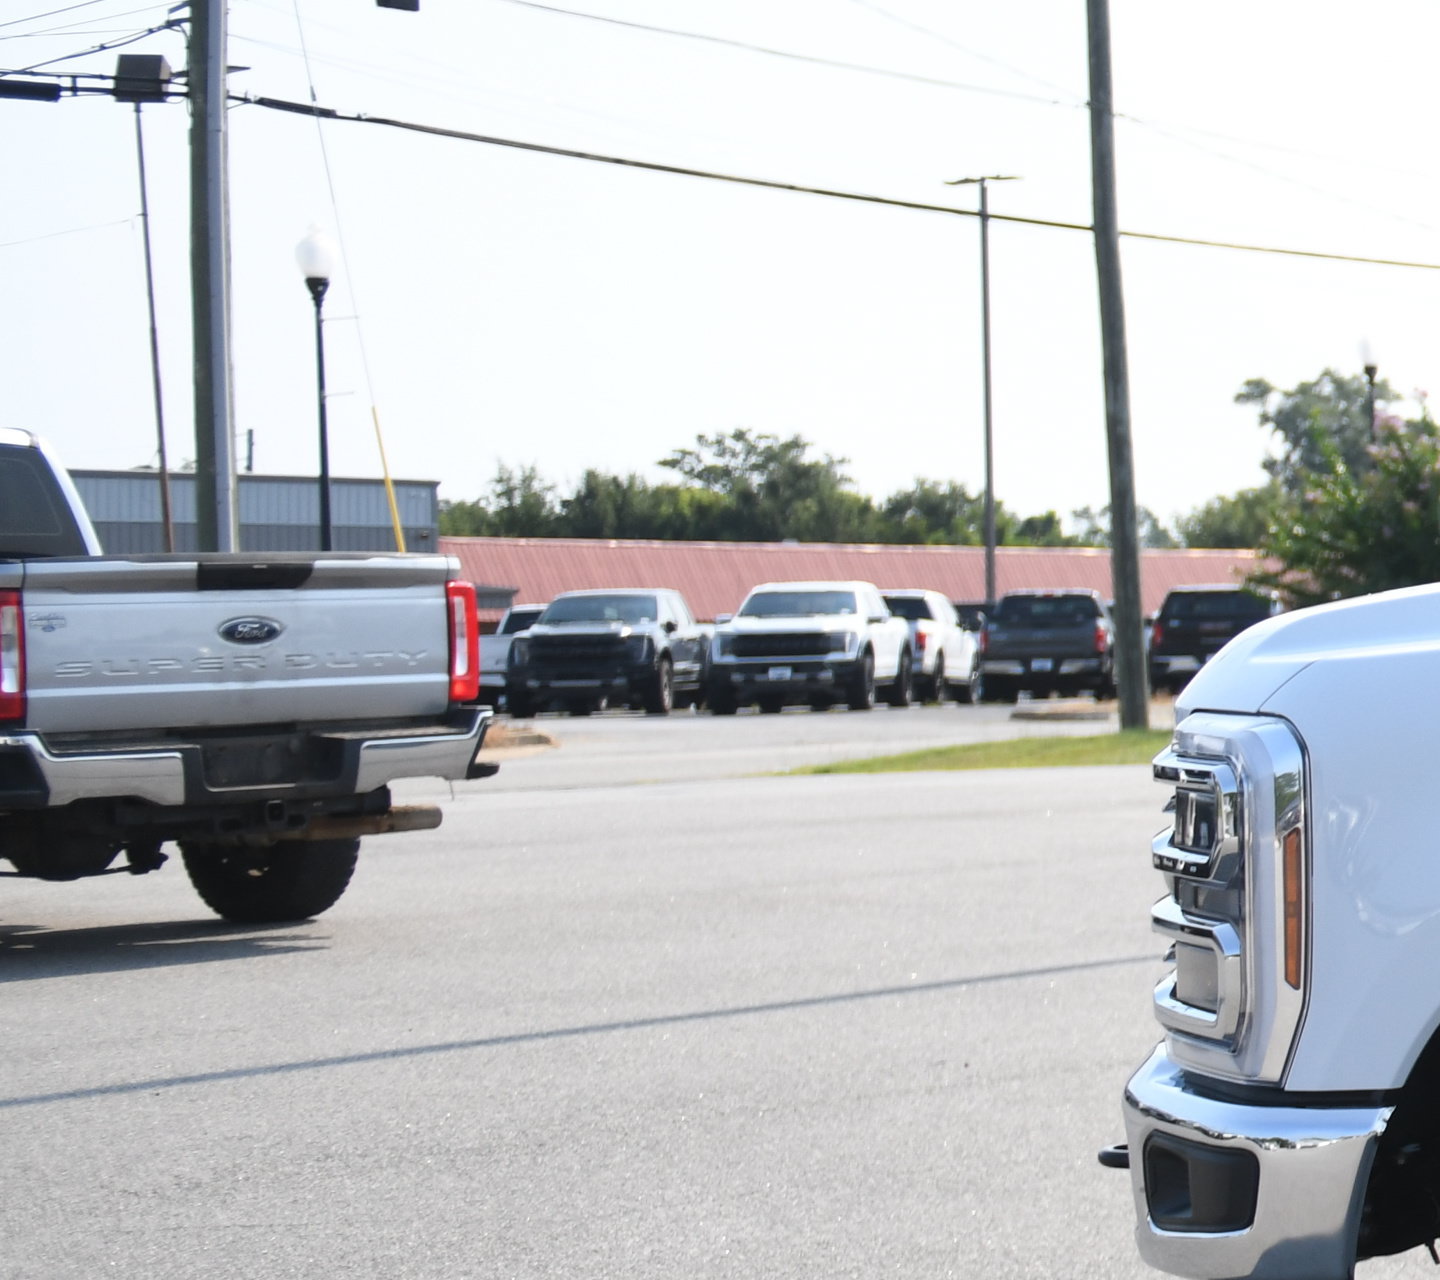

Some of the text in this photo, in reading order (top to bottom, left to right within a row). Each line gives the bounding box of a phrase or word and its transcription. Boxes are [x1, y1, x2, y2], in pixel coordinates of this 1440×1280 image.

[234, 623, 268, 639] Ford
[55, 648, 429, 678] SUPER DUTY
